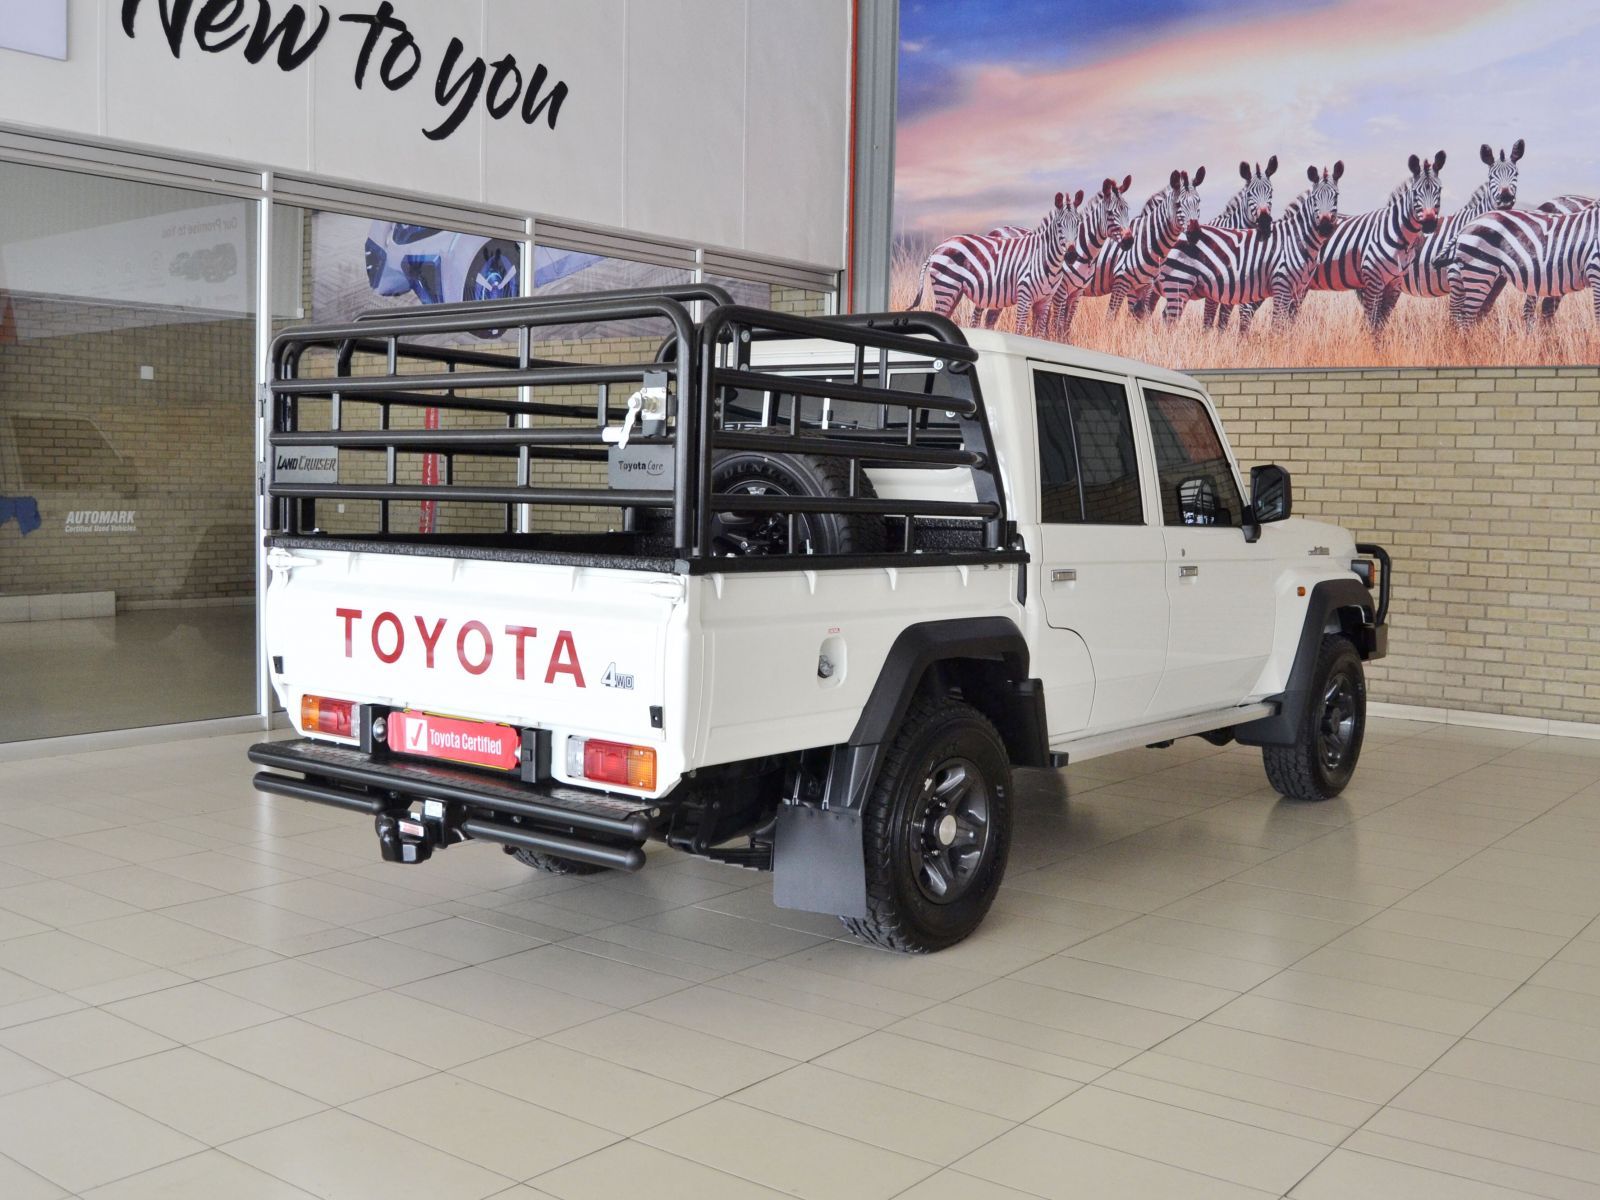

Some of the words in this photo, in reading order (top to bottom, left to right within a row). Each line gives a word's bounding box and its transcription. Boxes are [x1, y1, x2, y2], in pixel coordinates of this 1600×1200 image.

[121, 0, 329, 72] New
[338, 1, 422, 91] to
[421, 37, 569, 141] you
[276, 455, 299, 470] LAND
[299, 455, 337, 471] CRUISER
[64, 524, 93, 533] Certified
[65, 510, 137, 524] AUTOMARK
[336, 607, 587, 688] TOYOTA
[600, 661, 634, 690] 4WD
[430, 729, 460, 749] Toyota
[461, 733, 502, 755] Certified
